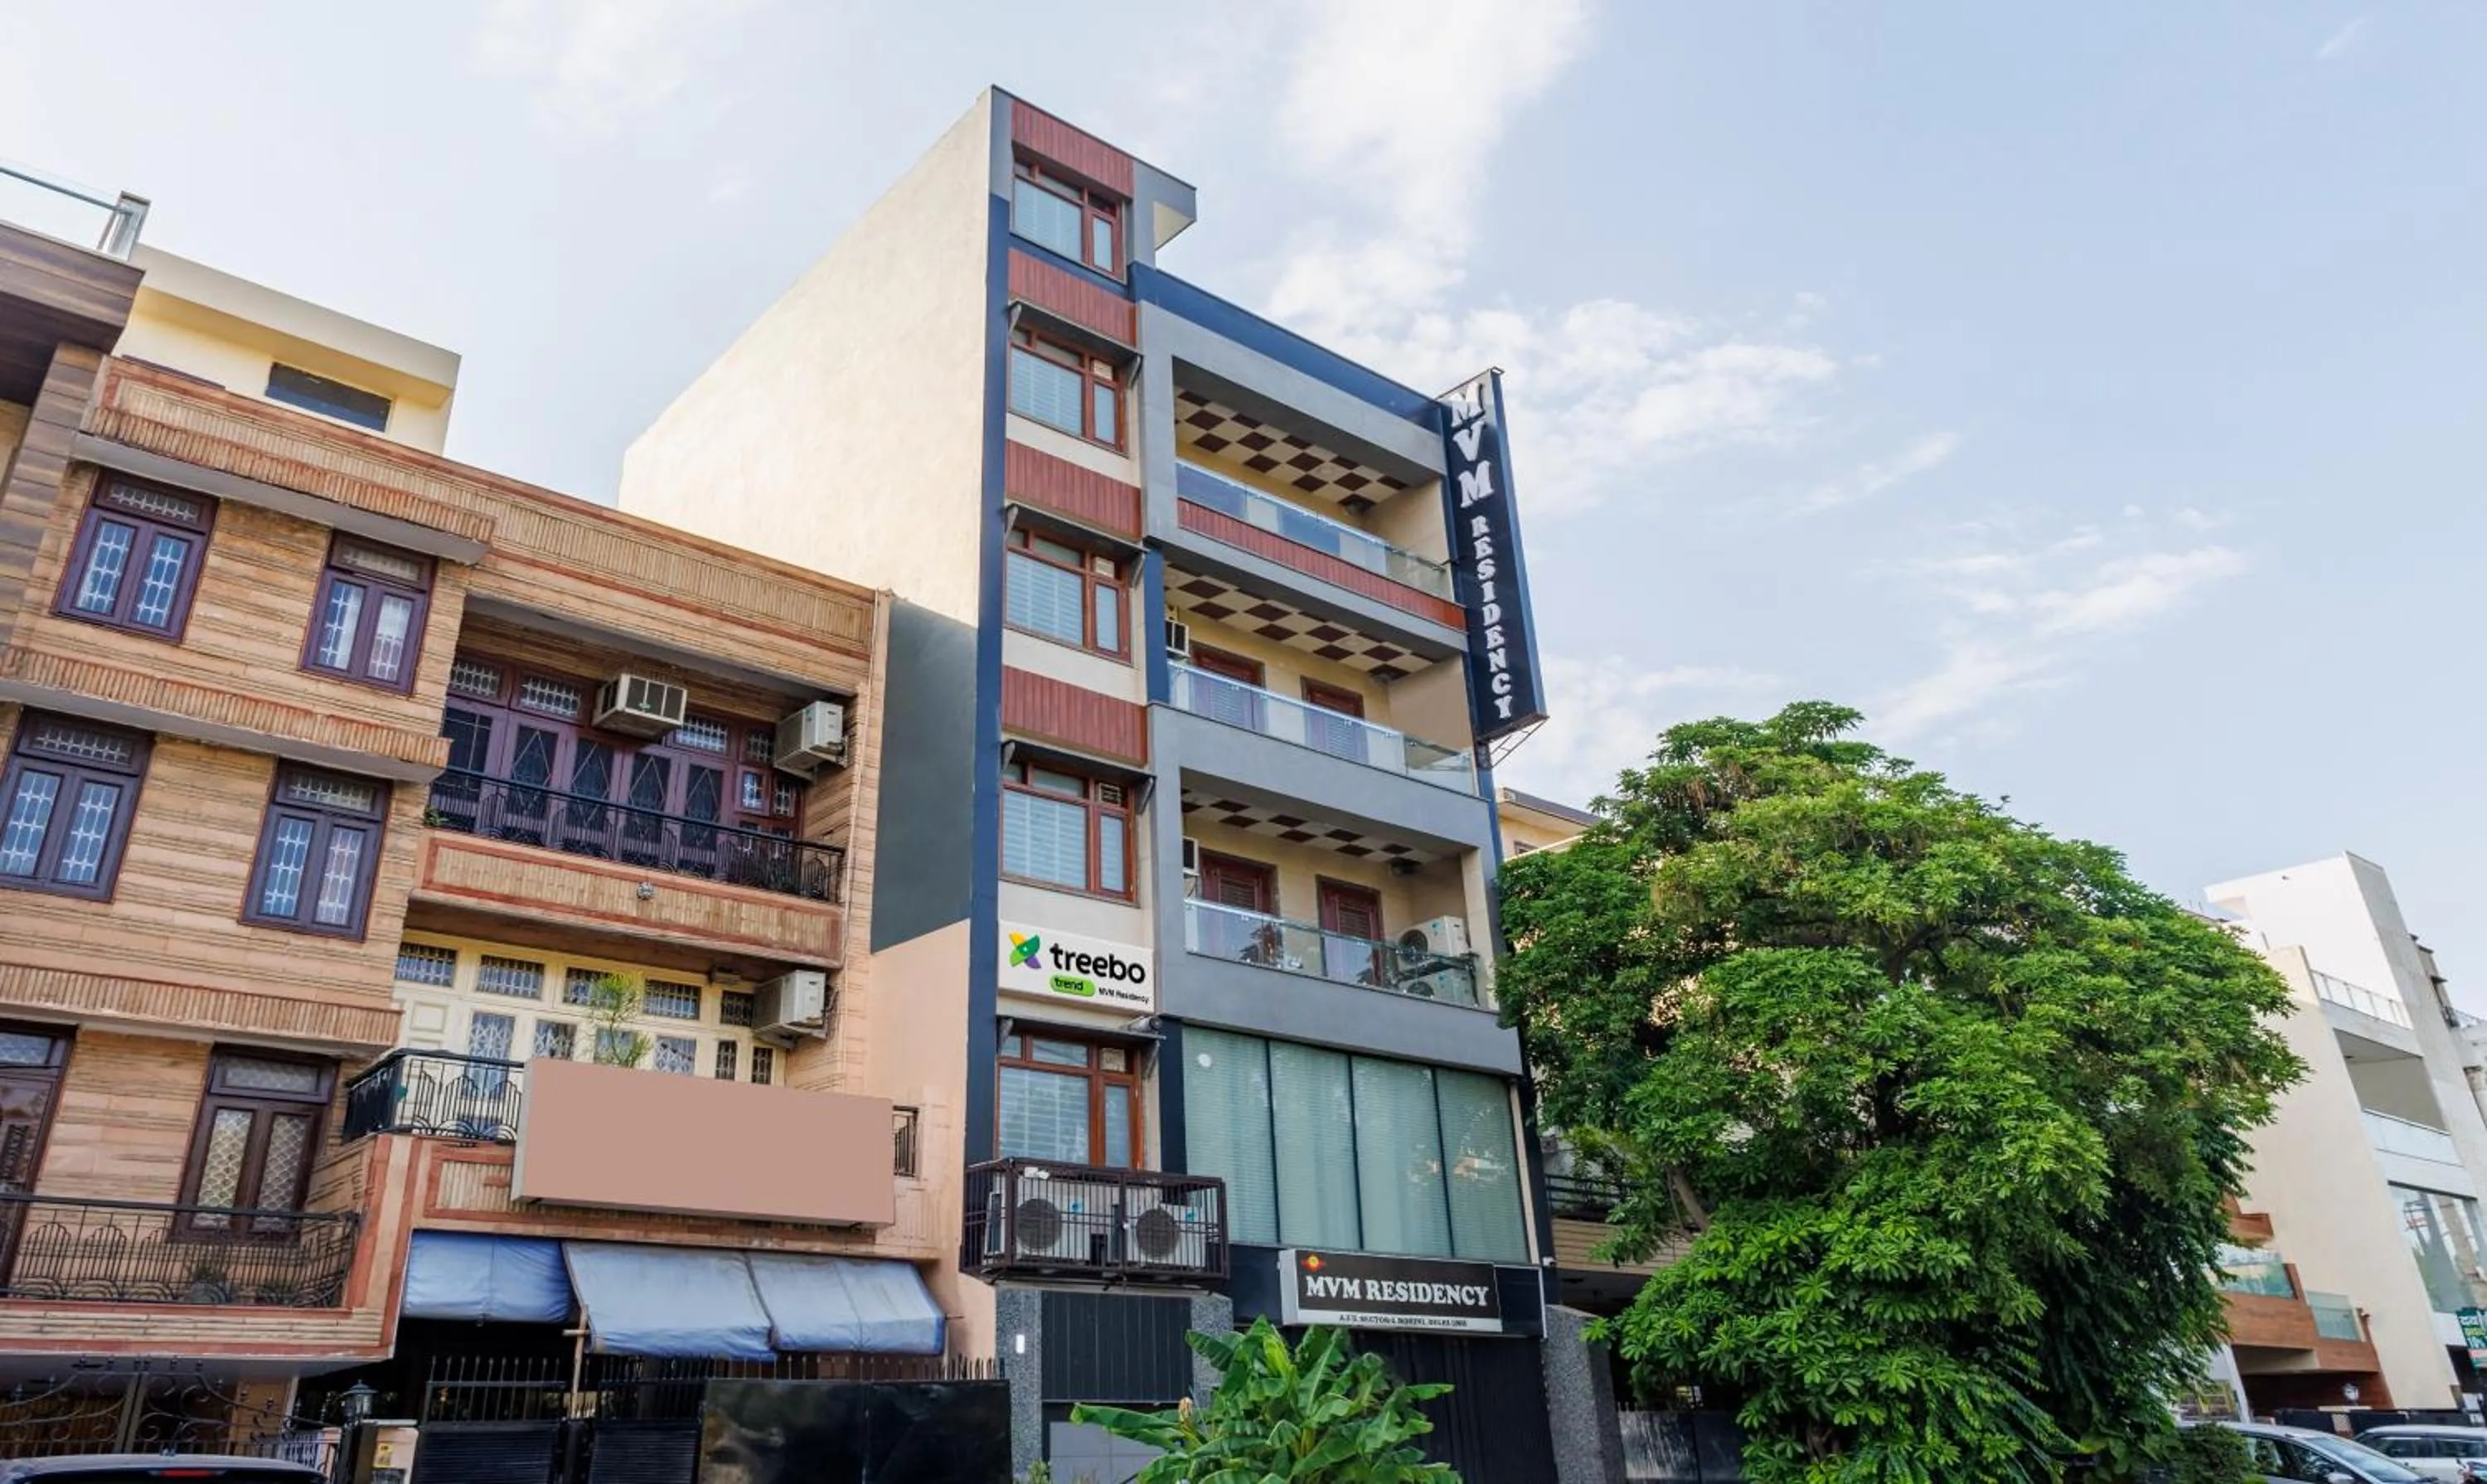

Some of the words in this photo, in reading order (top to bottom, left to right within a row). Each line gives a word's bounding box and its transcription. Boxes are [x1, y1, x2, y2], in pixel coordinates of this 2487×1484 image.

[1452, 381, 1494, 508] MVM
[1471, 515, 1512, 719] RESIDENCY
[1050, 943, 1146, 983] treebo
[1054, 977, 1084, 991] trend
[1306, 1276, 1360, 1299] MVM
[1365, 1279, 1488, 1307] RESIDENCY
